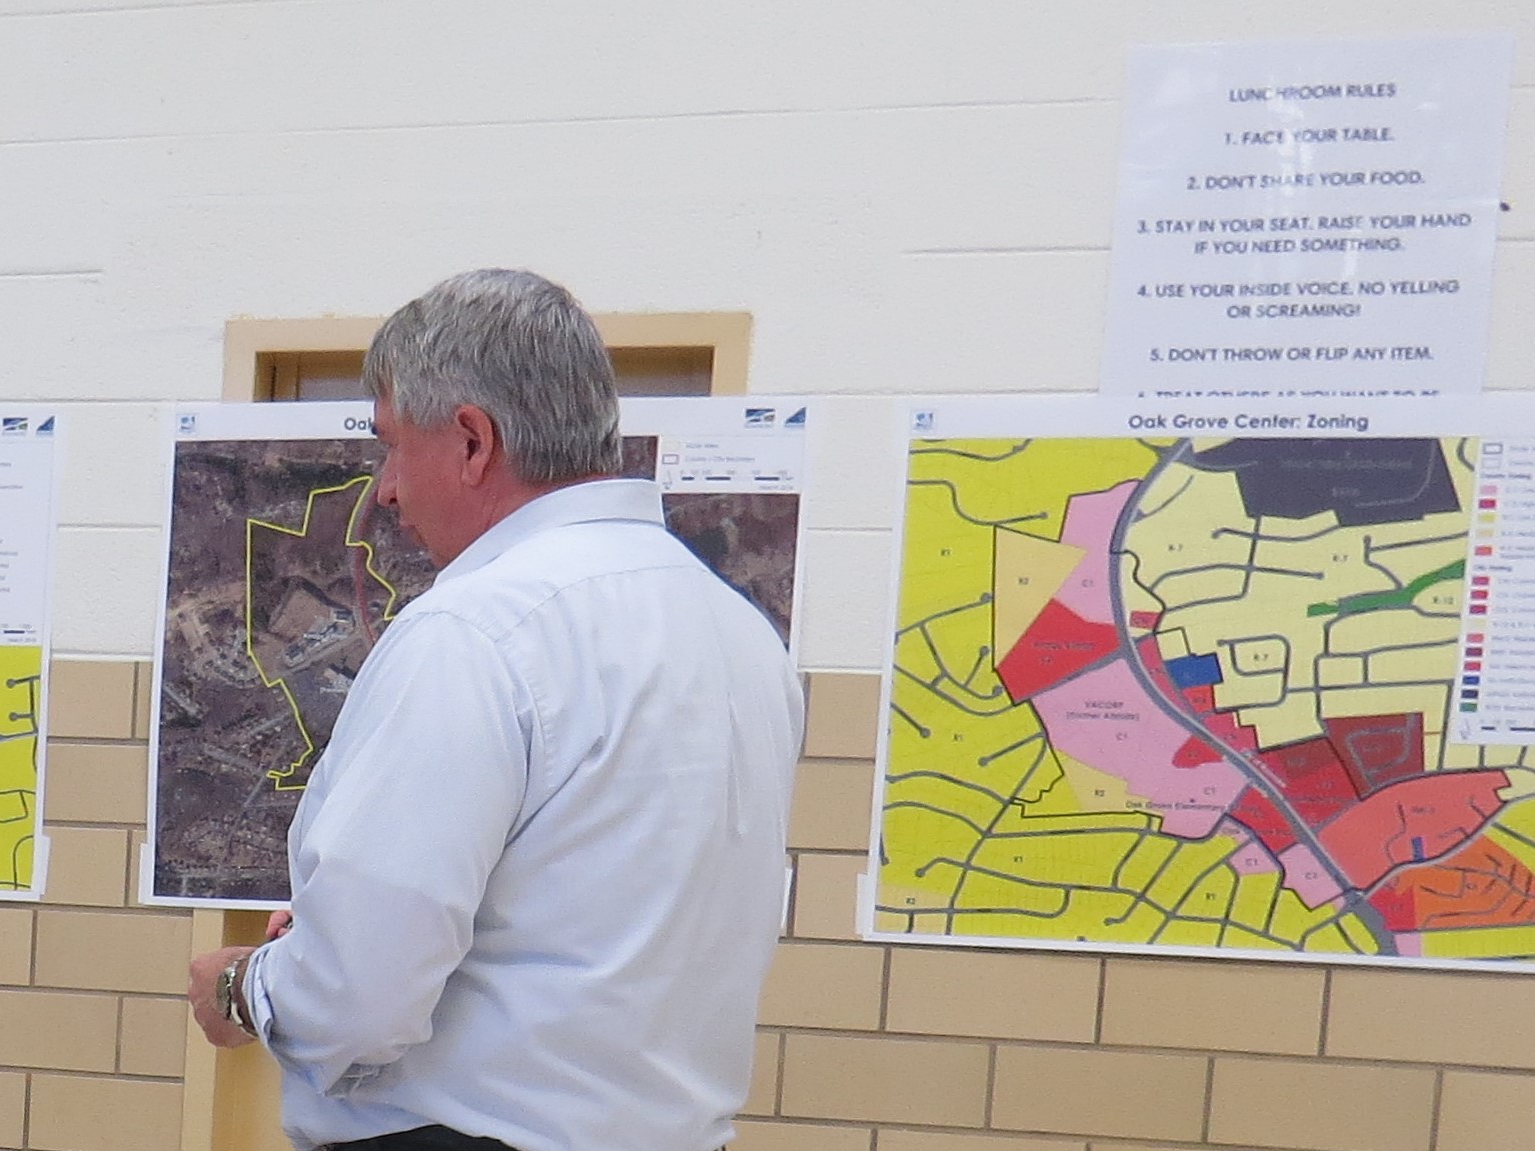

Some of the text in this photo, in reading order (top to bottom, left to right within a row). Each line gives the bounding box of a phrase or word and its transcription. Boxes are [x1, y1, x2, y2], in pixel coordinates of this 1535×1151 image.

[1346, 83, 1397, 98] RULES
[1225, 133, 1237, 145] 1.
[1343, 127, 1394, 142] TABLE.
[1186, 170, 1425, 190] 2. DON'T SHARE YOUR FOOD.
[1137, 213, 1471, 234] 3. STAY IN YOUR SEAT. RAISE YOUR HAND
[1194, 237, 1405, 254] IF YOU NEED SOMETHING.
[1137, 279, 1460, 298] 4. USE YOUR INSIDE VOICE. NO YELLING
[1227, 303, 1361, 318] OR SCREAMING!
[1150, 346, 1433, 362] 5. DON'T THROW OR FLIP ANY ITEM.
[1128, 413, 1369, 431] Oak Grove Center: Zoning
